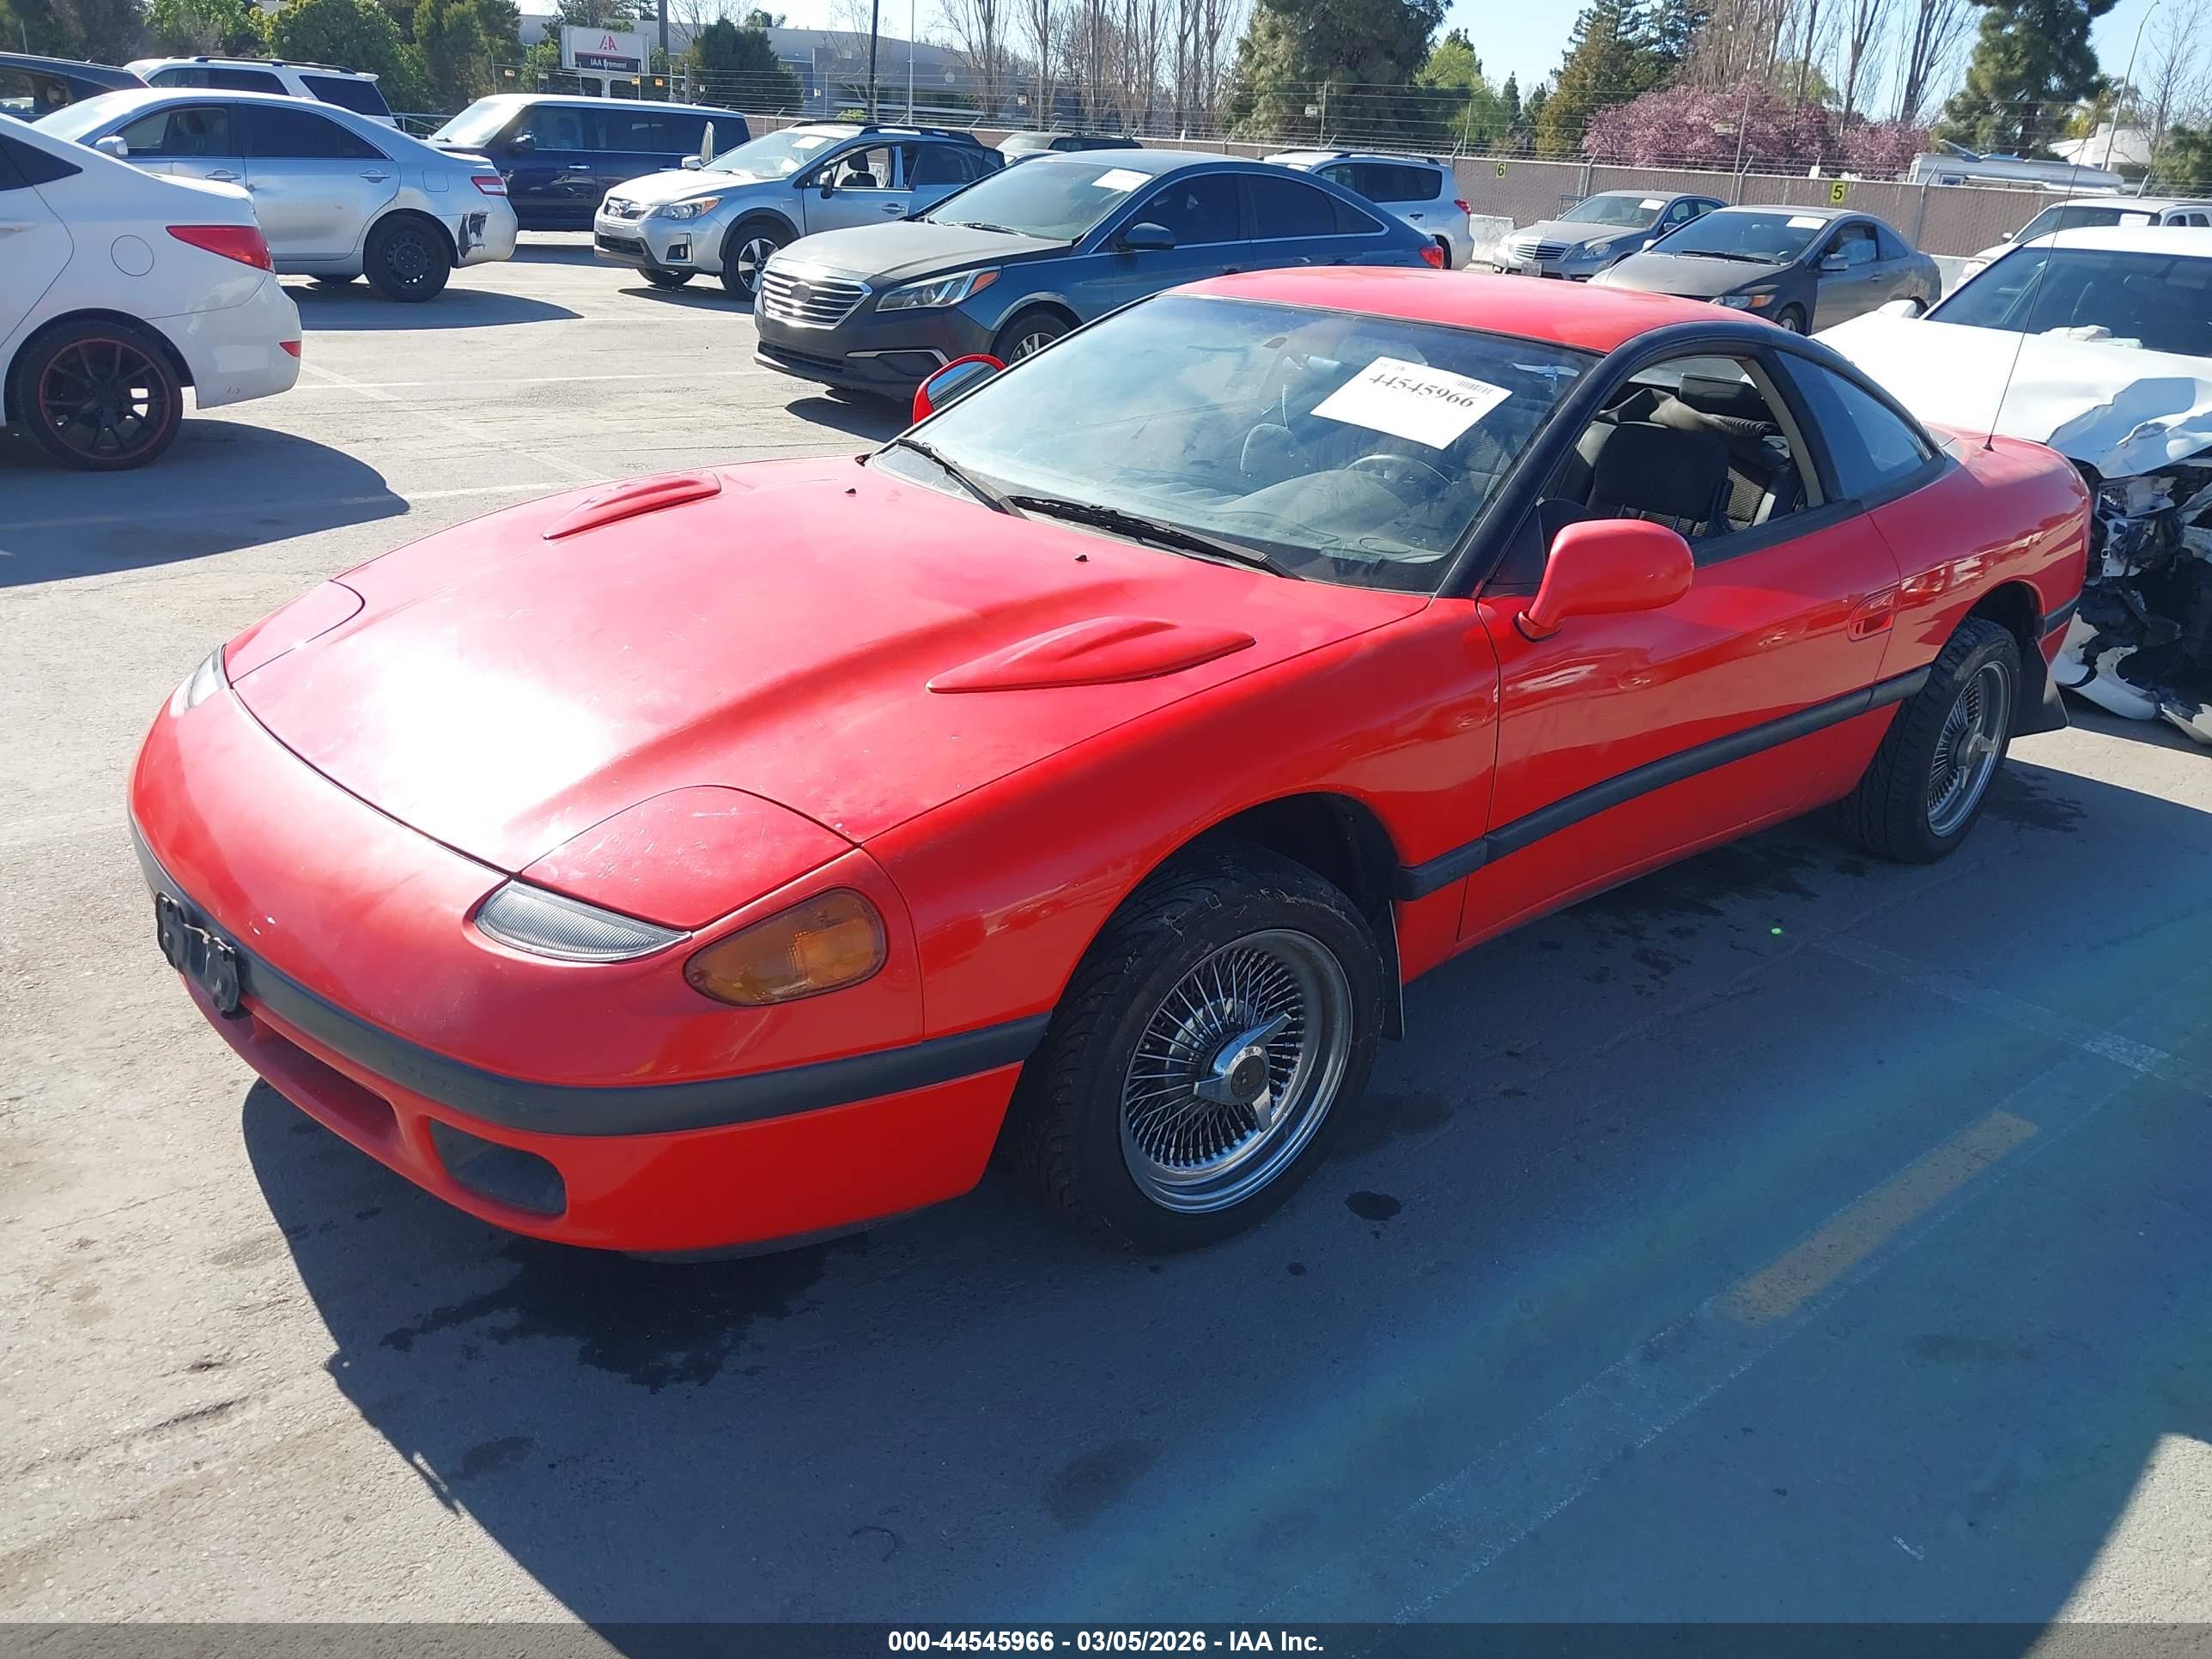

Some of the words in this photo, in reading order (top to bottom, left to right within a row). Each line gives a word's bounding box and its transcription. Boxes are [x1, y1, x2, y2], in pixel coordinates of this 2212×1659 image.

[1498, 163, 1505, 176] 6
[1832, 185, 1844, 199] 5
[1369, 374, 1479, 408] 44545966
